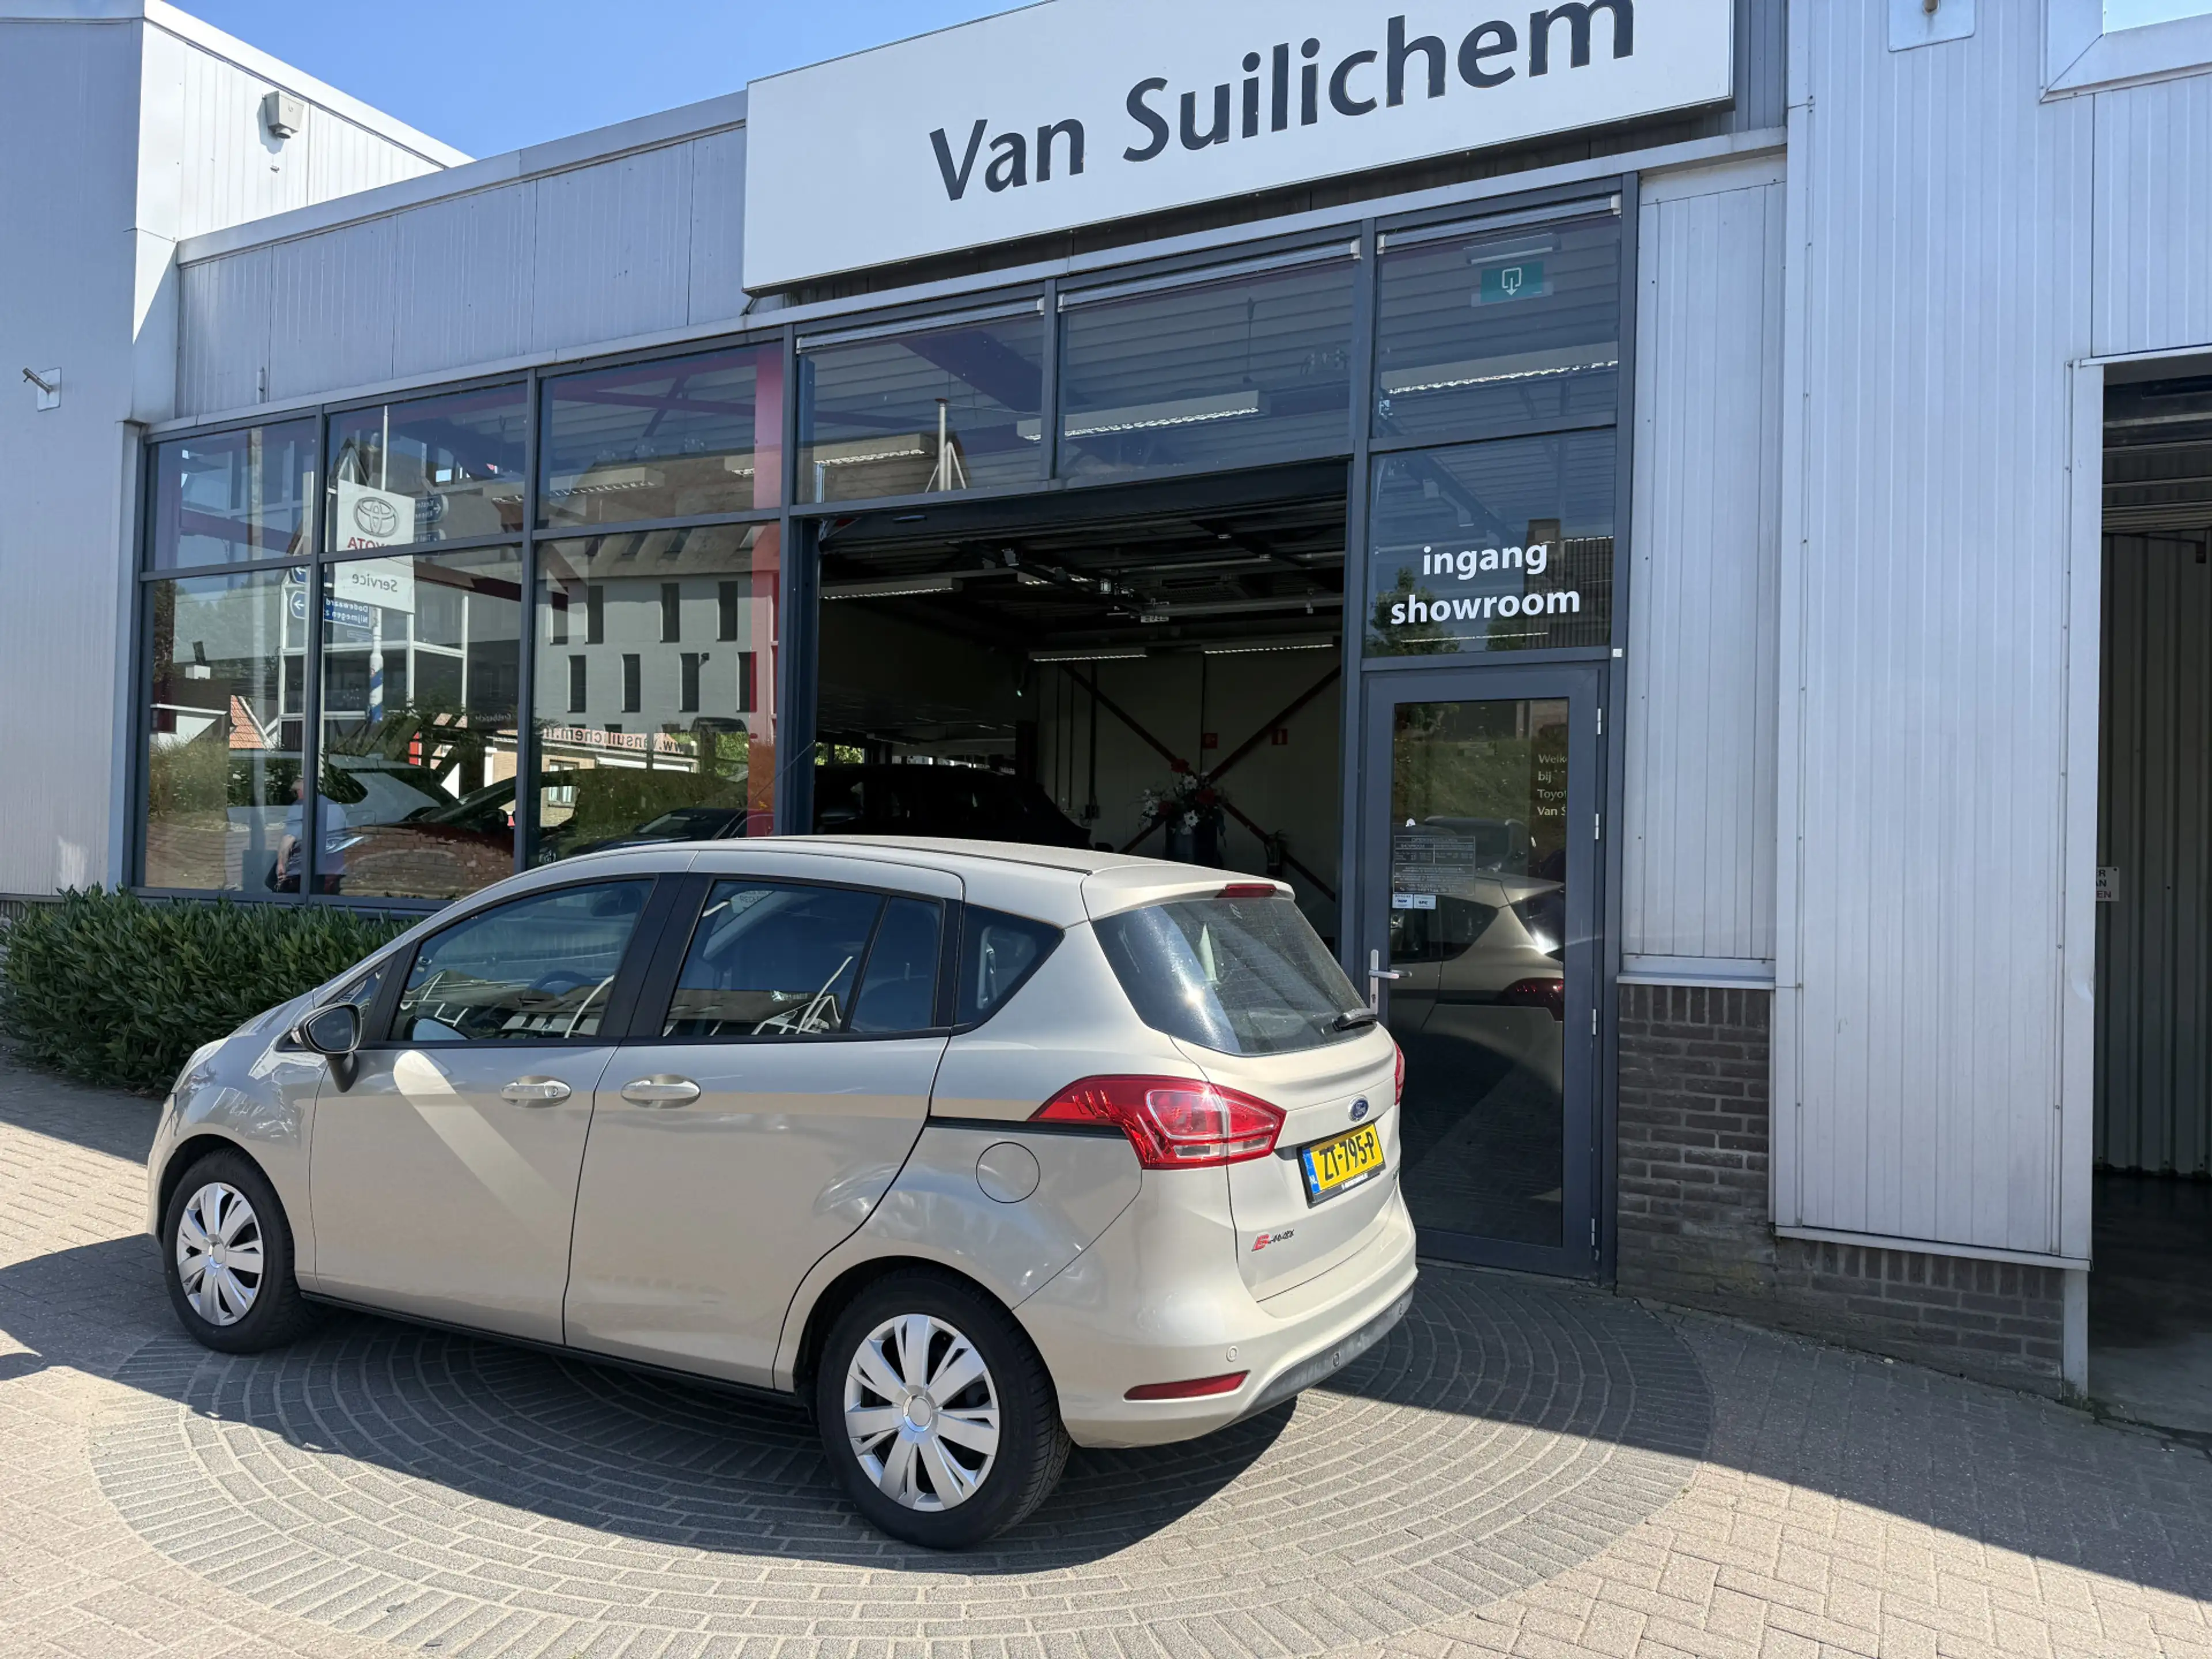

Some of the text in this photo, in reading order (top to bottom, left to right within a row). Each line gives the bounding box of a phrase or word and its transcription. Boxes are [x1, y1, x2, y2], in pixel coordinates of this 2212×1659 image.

[930, 0, 1633, 201] Van Suilichem
[1424, 545, 1546, 579] ingang
[1392, 592, 1579, 623] showroom
[1538, 753, 1567, 763] Welk
[1537, 770, 1552, 783] bij
[1537, 806, 1558, 816] Van
[1319, 1131, 1374, 1181] ZT-795-P
